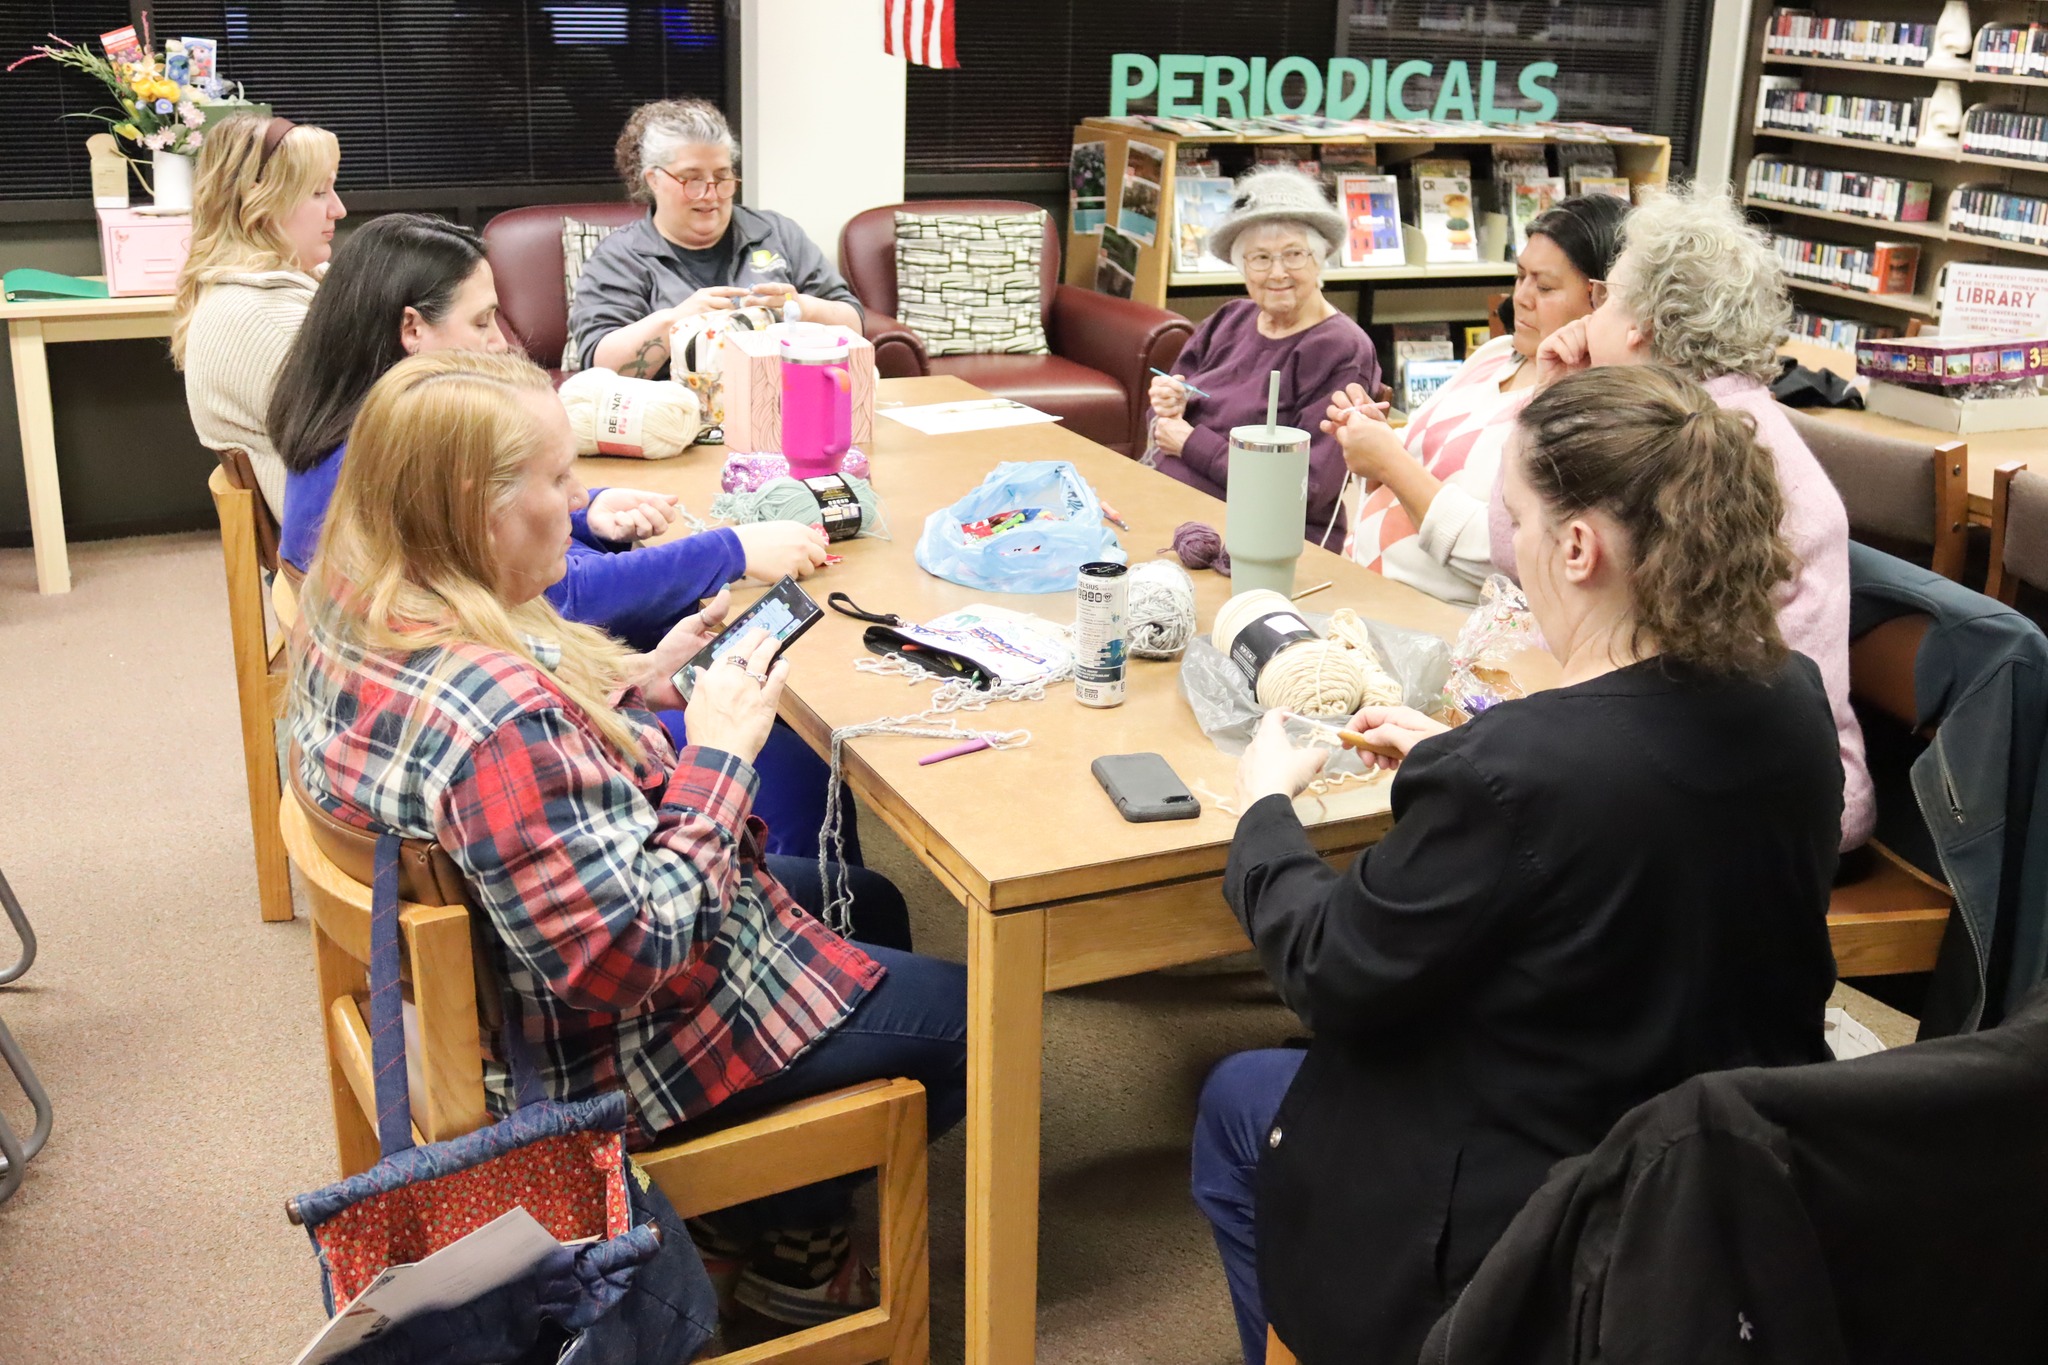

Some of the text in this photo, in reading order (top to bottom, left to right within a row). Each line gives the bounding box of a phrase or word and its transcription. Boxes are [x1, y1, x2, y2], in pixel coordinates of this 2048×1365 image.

[1110, 53, 1559, 123] PERIODICALS
[1423, 180, 1435, 190] CR
[1956, 286, 2036, 309] LIBRARY
[1907, 354, 1917, 373] 3
[2029, 347, 2041, 369] 3
[1411, 378, 1427, 392] CAR
[608, 392, 623, 434] BENAT
